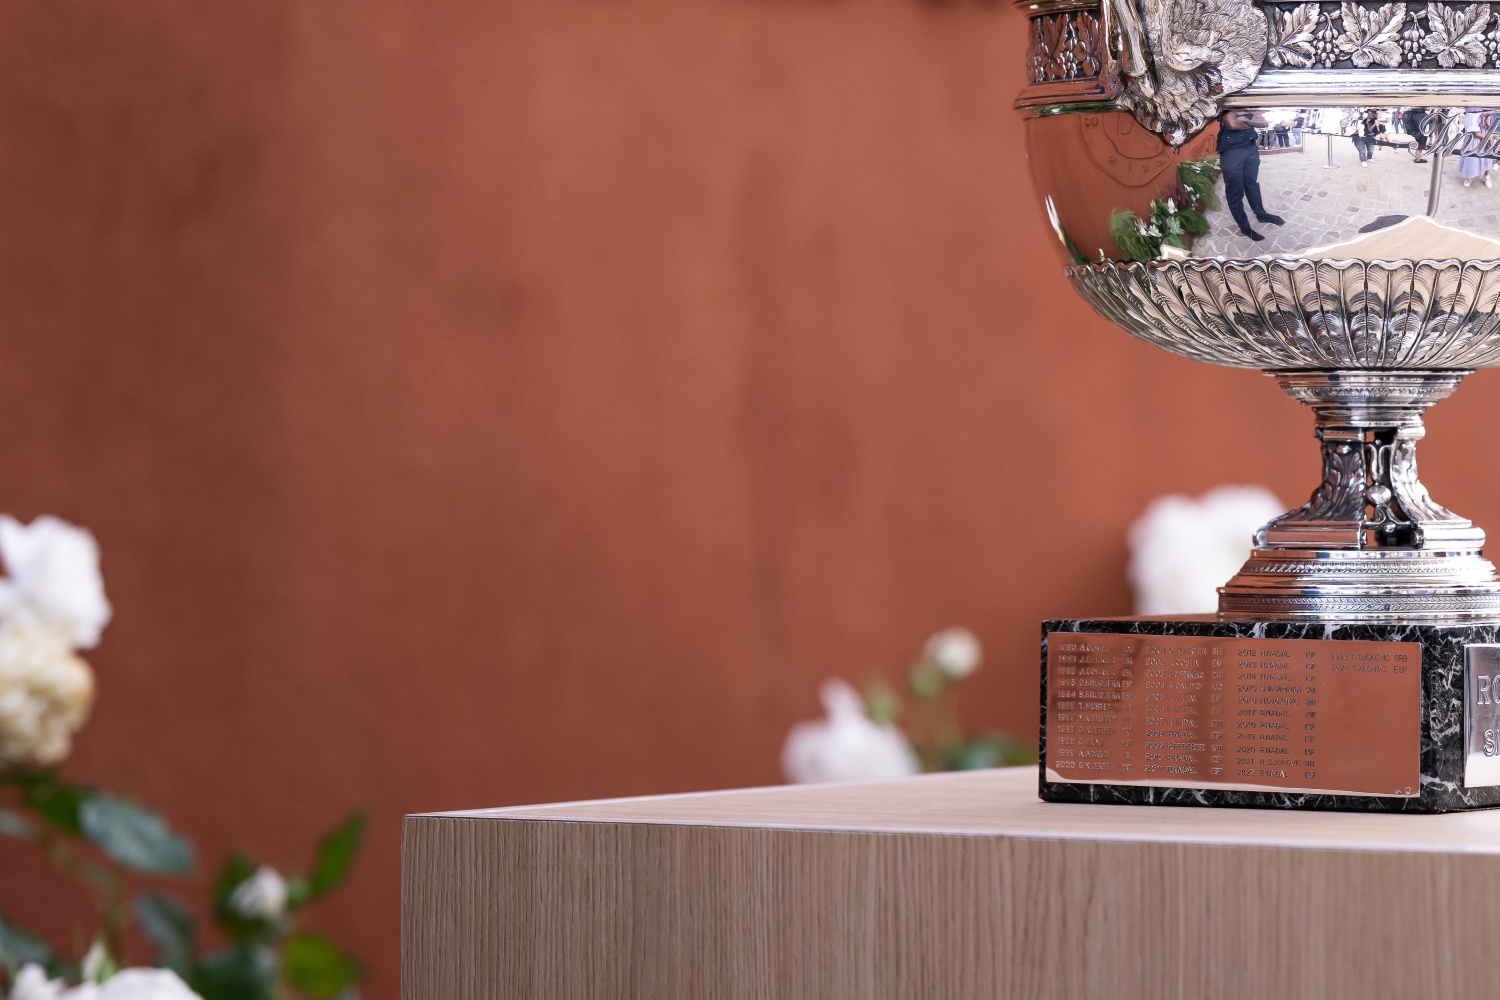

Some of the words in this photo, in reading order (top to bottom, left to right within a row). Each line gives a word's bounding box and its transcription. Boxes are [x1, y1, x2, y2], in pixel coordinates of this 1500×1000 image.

[1393, 654, 1408, 662] SRB
[1236, 757, 1254, 765] 2021
[1236, 768, 1255, 776] 2022
